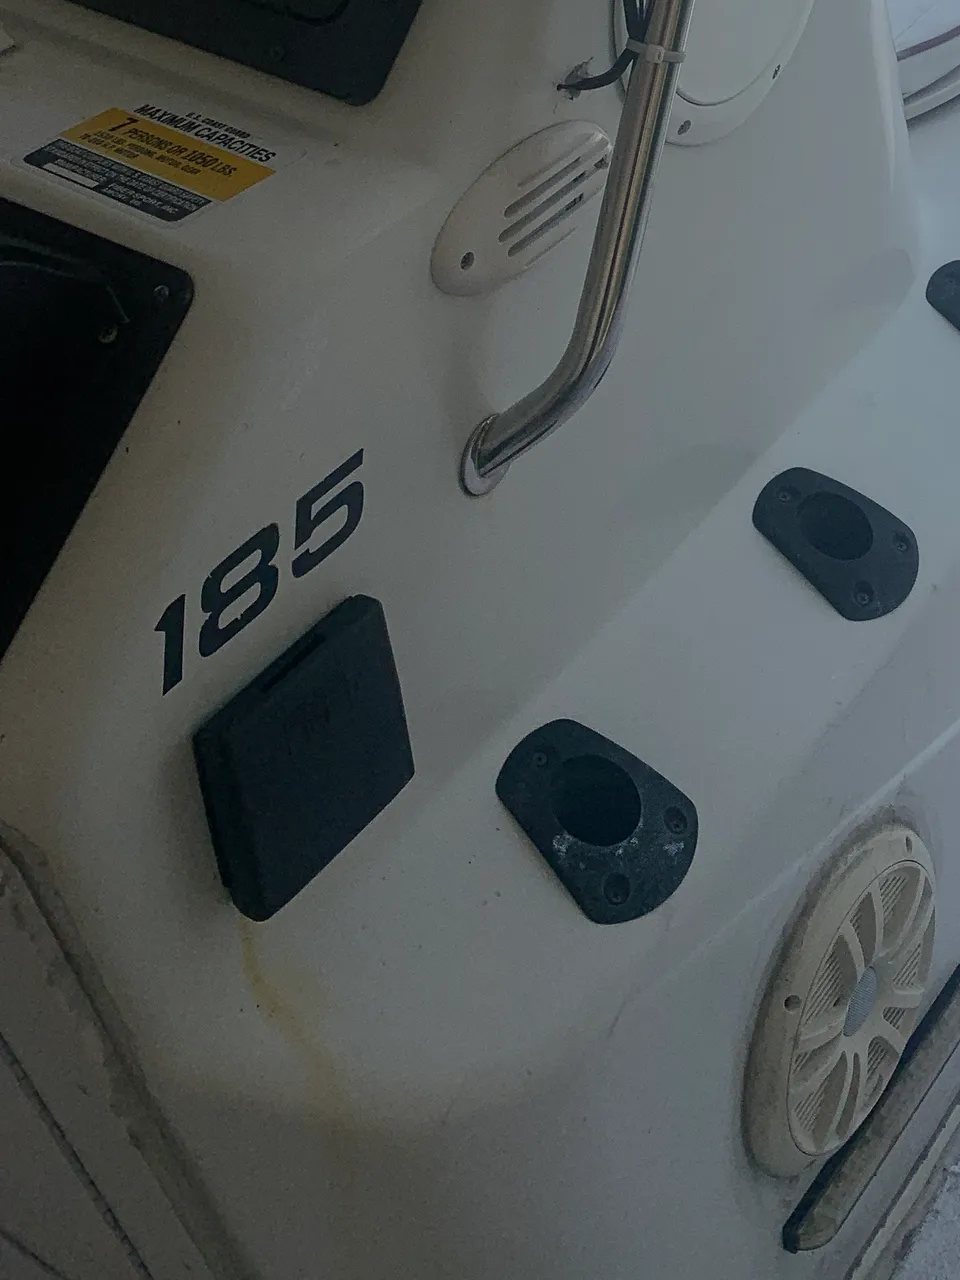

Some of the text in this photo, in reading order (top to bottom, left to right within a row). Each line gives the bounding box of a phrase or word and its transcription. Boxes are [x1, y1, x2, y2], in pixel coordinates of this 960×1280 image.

[109, 118, 139, 131] 7
[134, 104, 276, 162] MAXIMUM CAPACITIES
[123, 128, 173, 150] PERSONS
[166, 145, 188, 156] OR
[180, 150, 219, 167] 1050
[154, 448, 364, 696] 185
